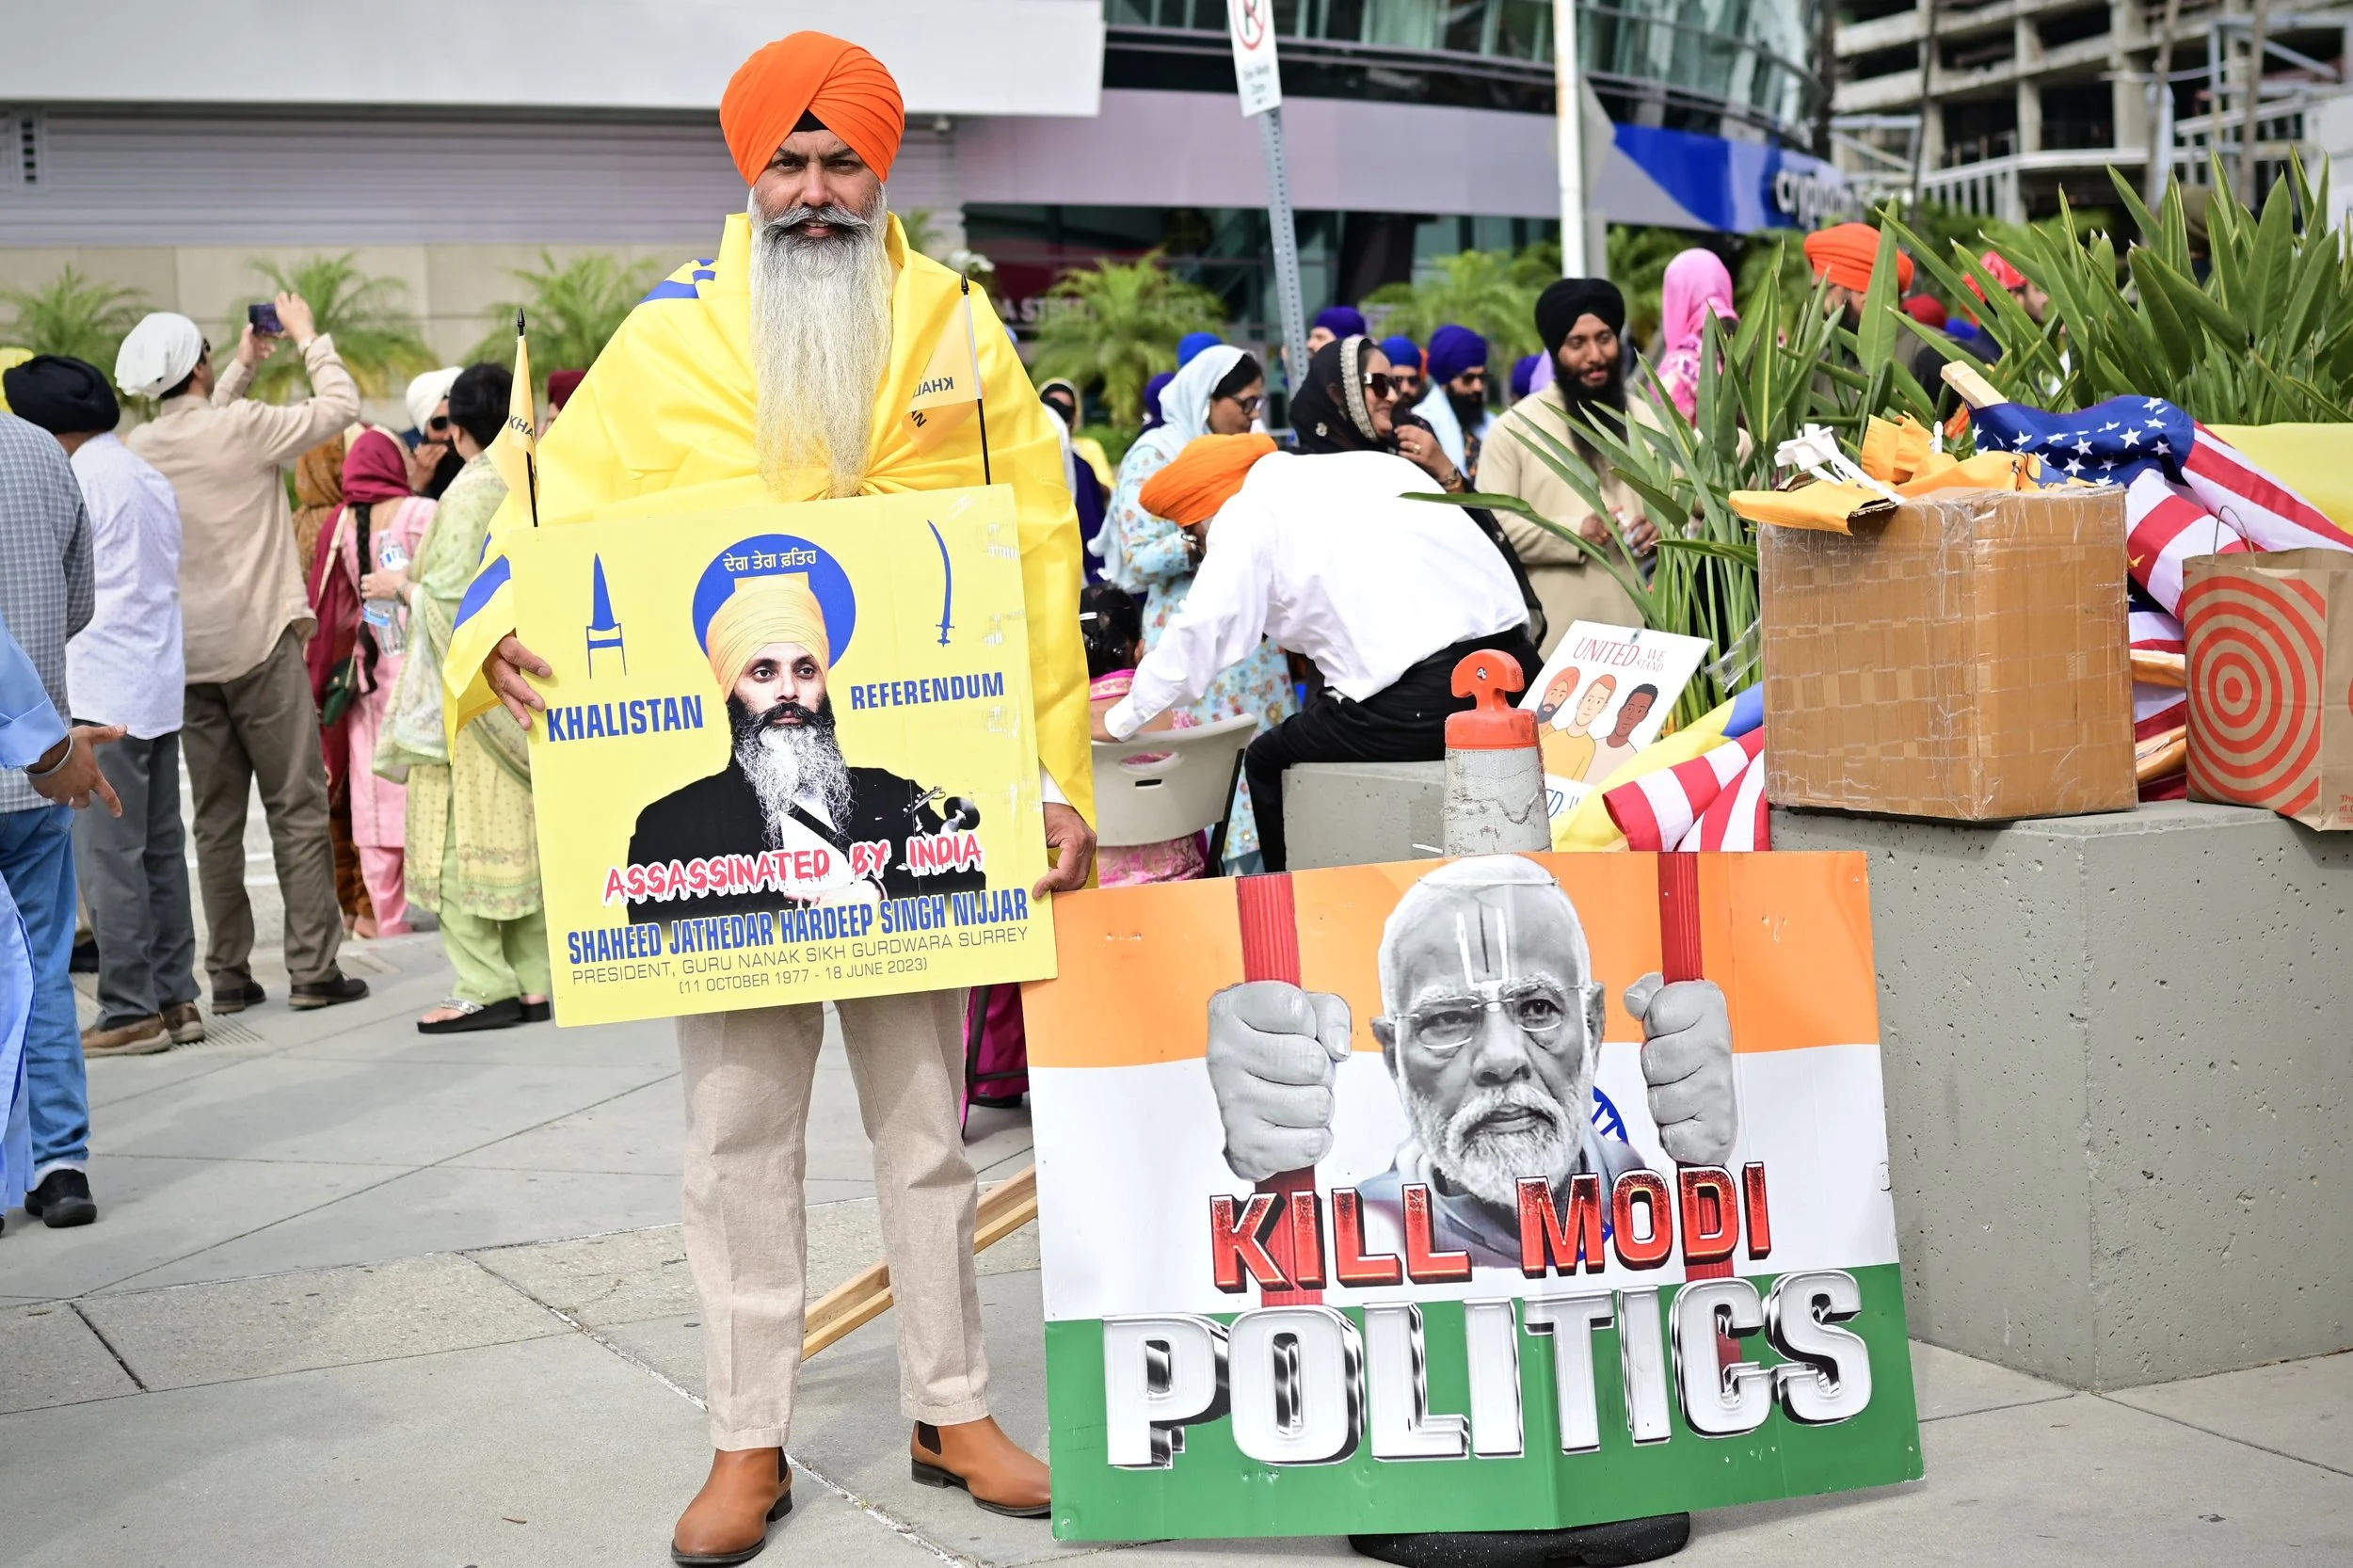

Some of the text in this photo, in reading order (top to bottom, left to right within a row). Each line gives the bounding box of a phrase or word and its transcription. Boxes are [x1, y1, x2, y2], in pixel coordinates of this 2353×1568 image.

[722, 552, 749, 572] ਦੇਗ
[750, 550, 777, 569] ਤੇਗ
[1573, 637, 1641, 666] UNITED
[850, 672, 1004, 710] REFERENDUM
[546, 695, 704, 742] KHALISTAN
[604, 834, 983, 902] ASSASSINATED BY INDIA
[568, 888, 1029, 965] SHAHEED JATHEDAR HARDEEP SINGH NIJJAR
[572, 925, 1029, 985] PRESIDENT, GURU NANAK SIKH GURDWARA SURREY
[679, 980, 699, 994] (11
[706, 975, 770, 992] OCTOBER
[775, 969, 809, 985] 1977
[824, 966, 842, 980] 18
[846, 961, 883, 978] JUNE
[888, 956, 928, 974] 2023)
[1209, 1161, 1773, 1292] KILL MODI
[1101, 1269, 1874, 1470] POLITICS
